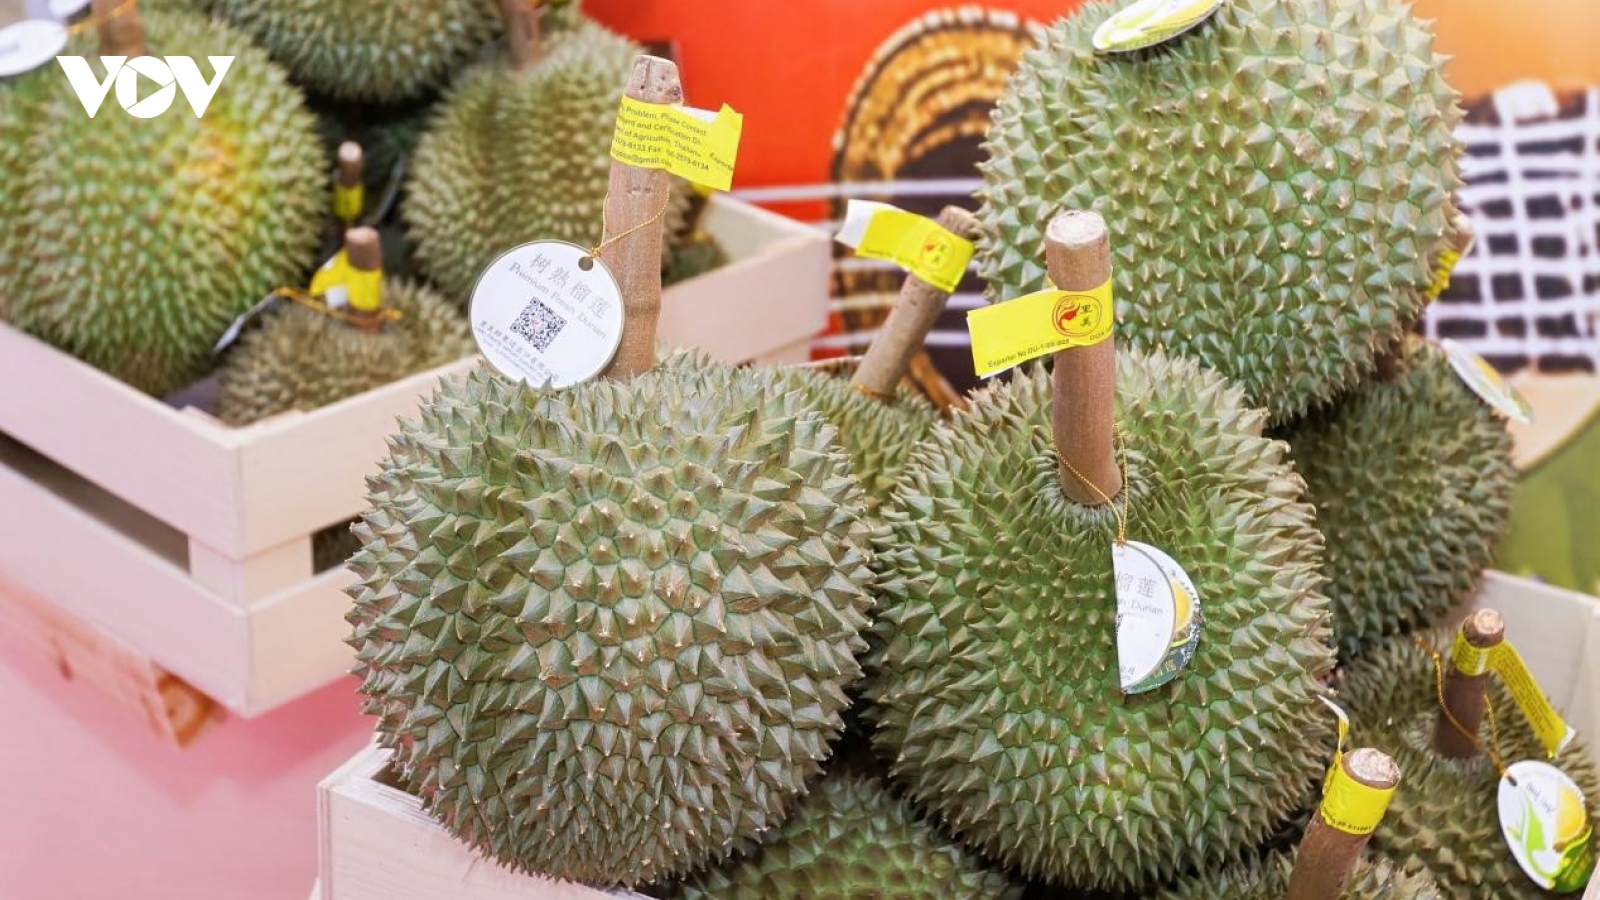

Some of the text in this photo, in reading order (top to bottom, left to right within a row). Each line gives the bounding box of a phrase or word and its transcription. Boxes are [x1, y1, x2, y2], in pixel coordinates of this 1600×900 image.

[637, 121, 652, 131] and
[681, 120, 707, 137] Contact
[509, 261, 549, 295] Premium
[577, 312, 608, 340] Durian
[1131, 600, 1164, 615] Durian
